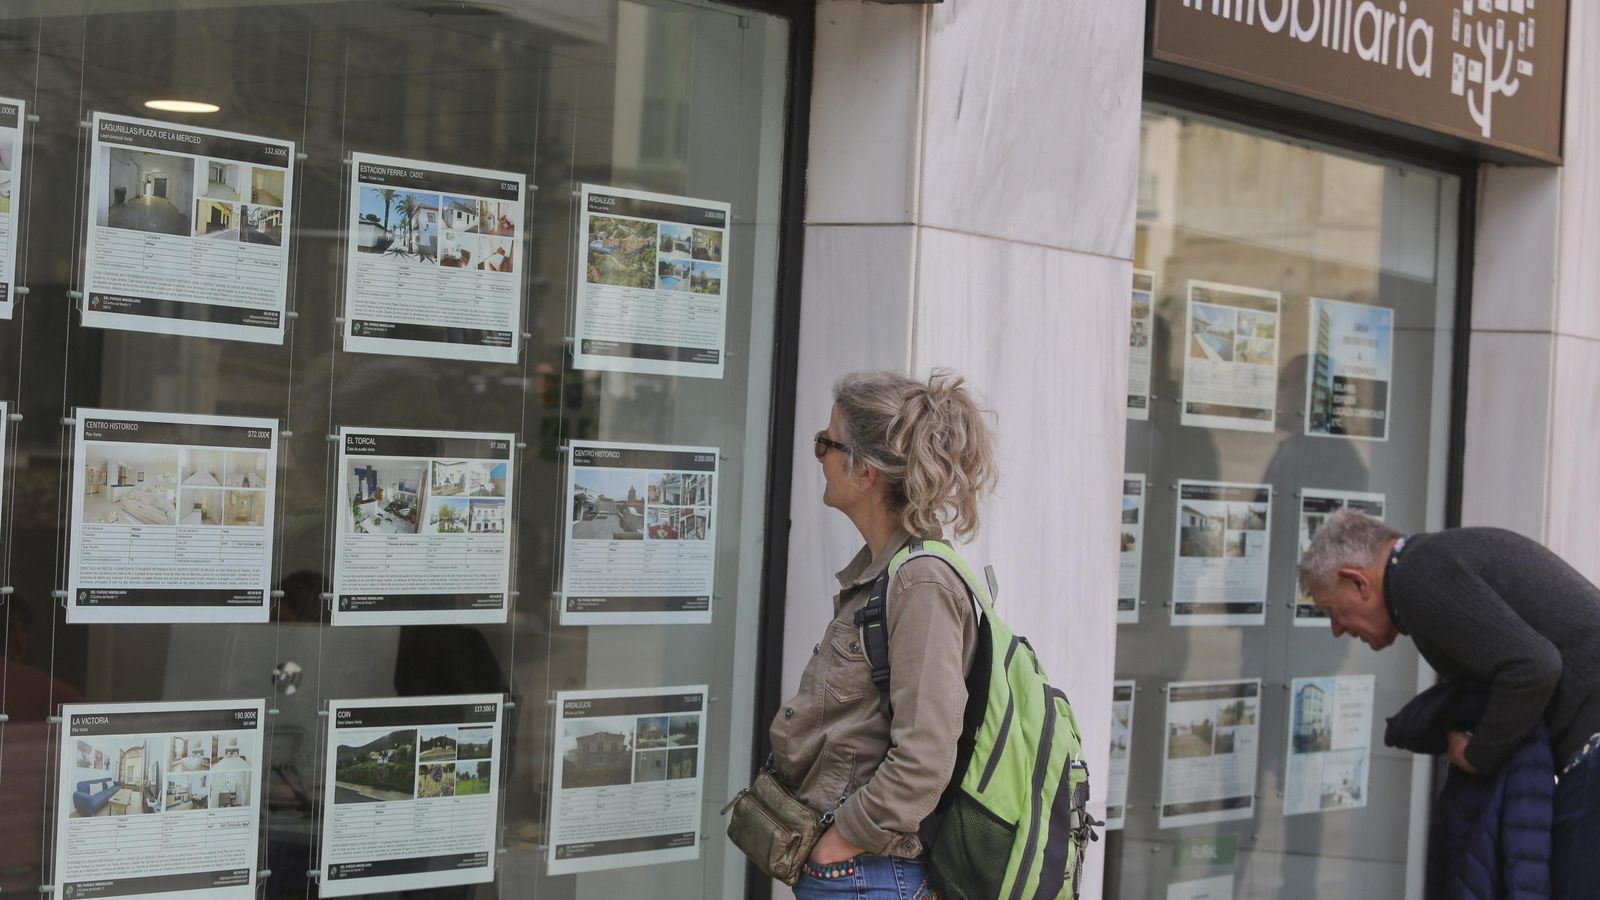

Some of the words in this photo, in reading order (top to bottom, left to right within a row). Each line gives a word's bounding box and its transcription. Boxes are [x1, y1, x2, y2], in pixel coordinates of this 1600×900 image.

[158, 131, 167, 140] DE
[167, 132, 175, 140] LA
[176, 133, 201, 144] MERCED
[264, 146, 287, 157] 132.600€
[360, 165, 387, 175] ESTACION
[386, 168, 407, 178] FERREA
[409, 171, 424, 179] CADIZ
[86, 421, 109, 430] CENTRO
[109, 422, 138, 431] HISTORICO
[247, 430, 270, 439] 372.000€
[347, 436, 354, 445] EL
[355, 437, 376, 446] TORCAL
[574, 449, 594, 457] CENTRO
[595, 451, 620, 459] HISTORICO
[234, 711, 256, 720] 190.900€
[337, 711, 351, 719] COIN
[72, 717, 81, 726] LA
[81, 716, 109, 725] VICTORIA
